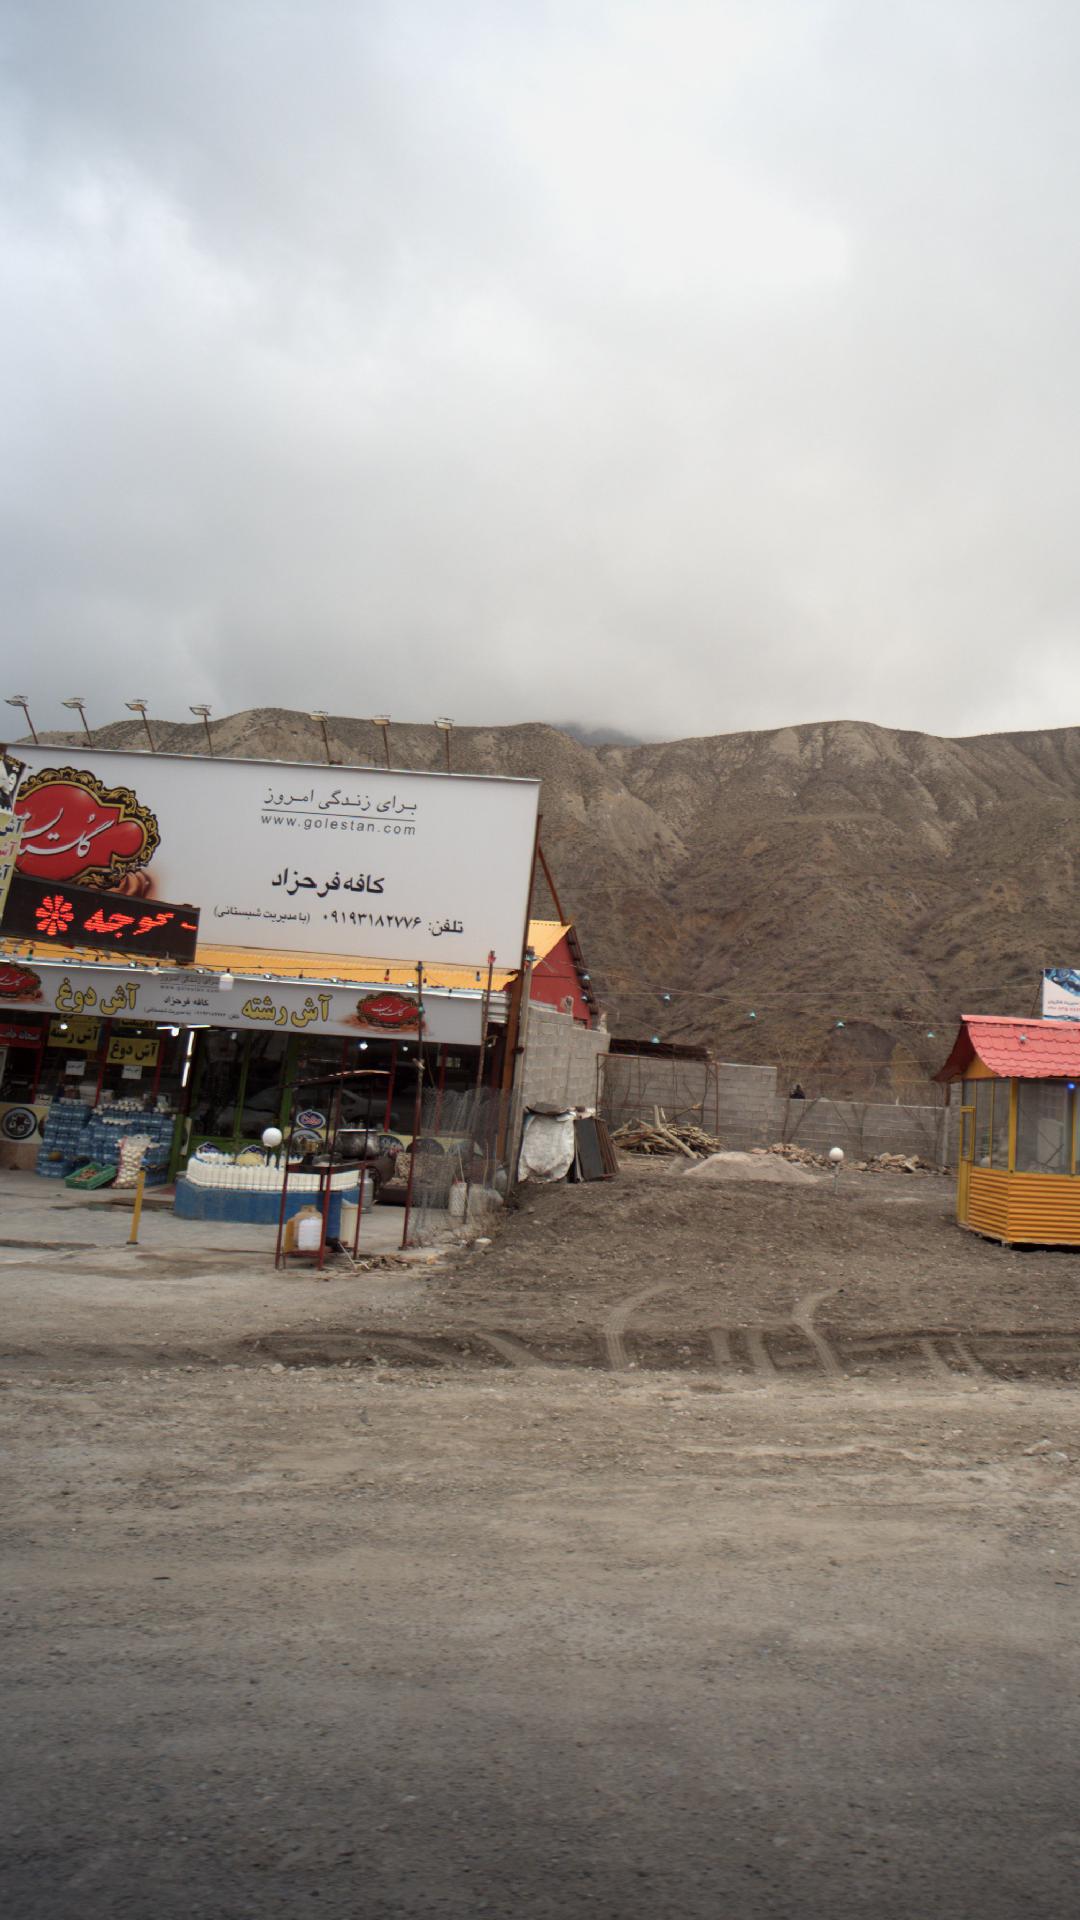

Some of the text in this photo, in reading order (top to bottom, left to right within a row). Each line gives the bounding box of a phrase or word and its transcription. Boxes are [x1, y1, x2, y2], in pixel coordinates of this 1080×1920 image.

[264, 787, 417, 815] برای زندگی امروز
[261, 814, 416, 836] www.golestan.com
[271, 867, 385, 898] کافه فرحزاد
[263, 911, 297, 923] مدیریت
[55, 977, 140, 1015] آش دوغ
[242, 994, 333, 1028] آش رشته
